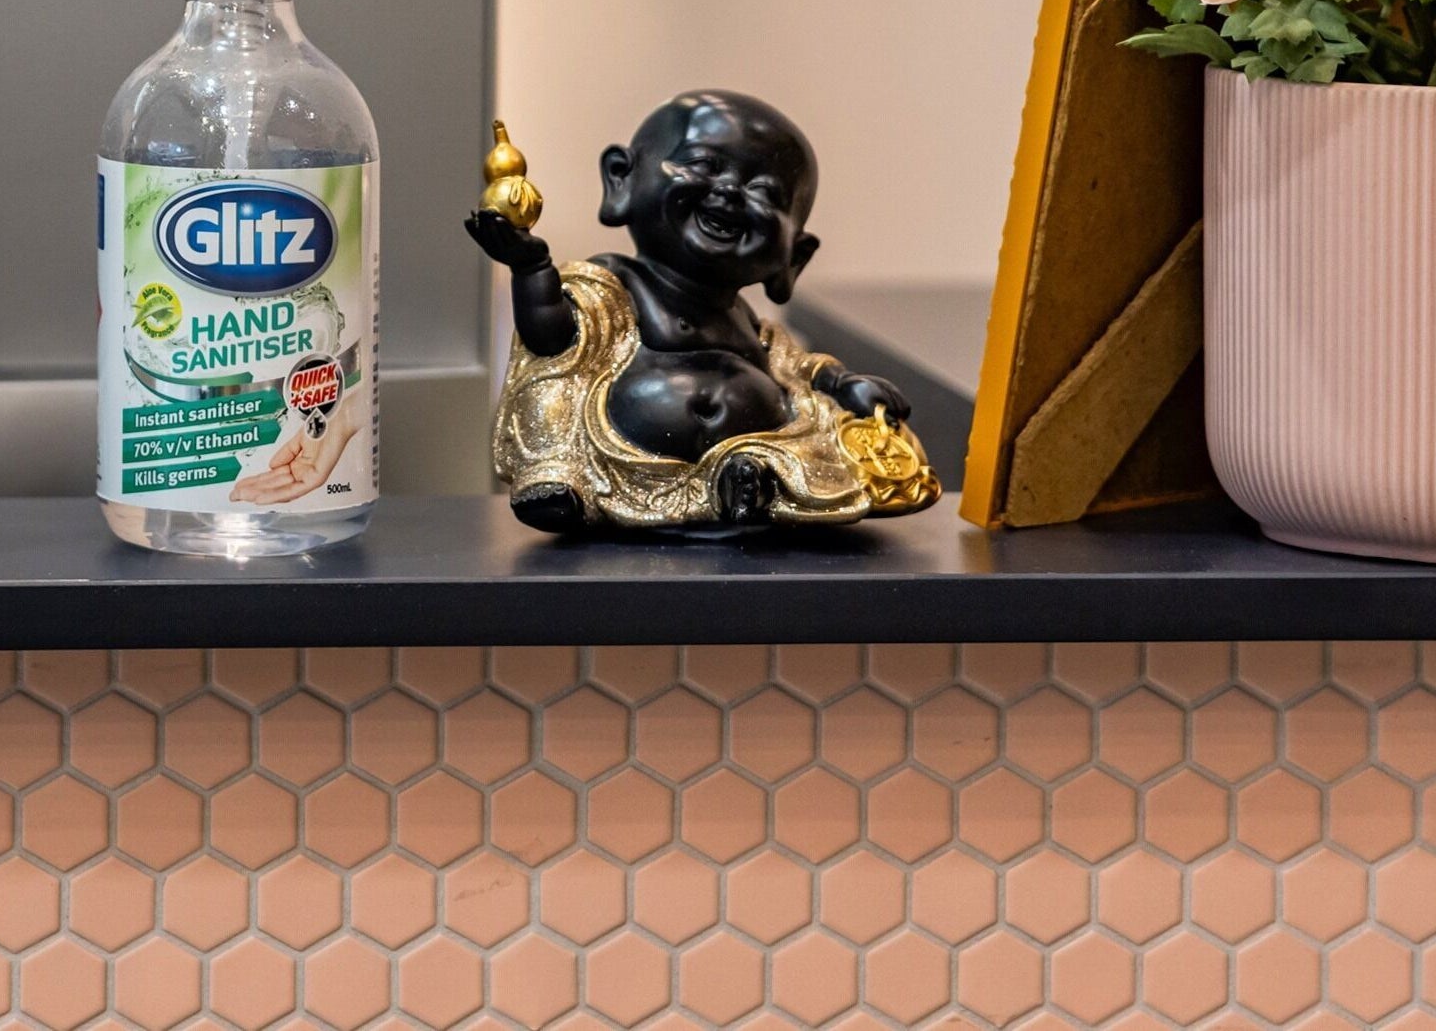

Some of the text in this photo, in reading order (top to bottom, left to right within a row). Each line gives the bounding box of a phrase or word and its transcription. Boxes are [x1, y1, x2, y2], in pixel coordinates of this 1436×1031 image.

[173, 201, 316, 267] Glitz
[191, 301, 295, 345] HAND
[171, 328, 313, 374] SANITISER
[291, 363, 337, 392] QUICK
[135, 399, 262, 428] Instant sanitiser
[134, 426, 260, 458] 70% v/v Ethanol
[134, 466, 218, 487] Kills germs
